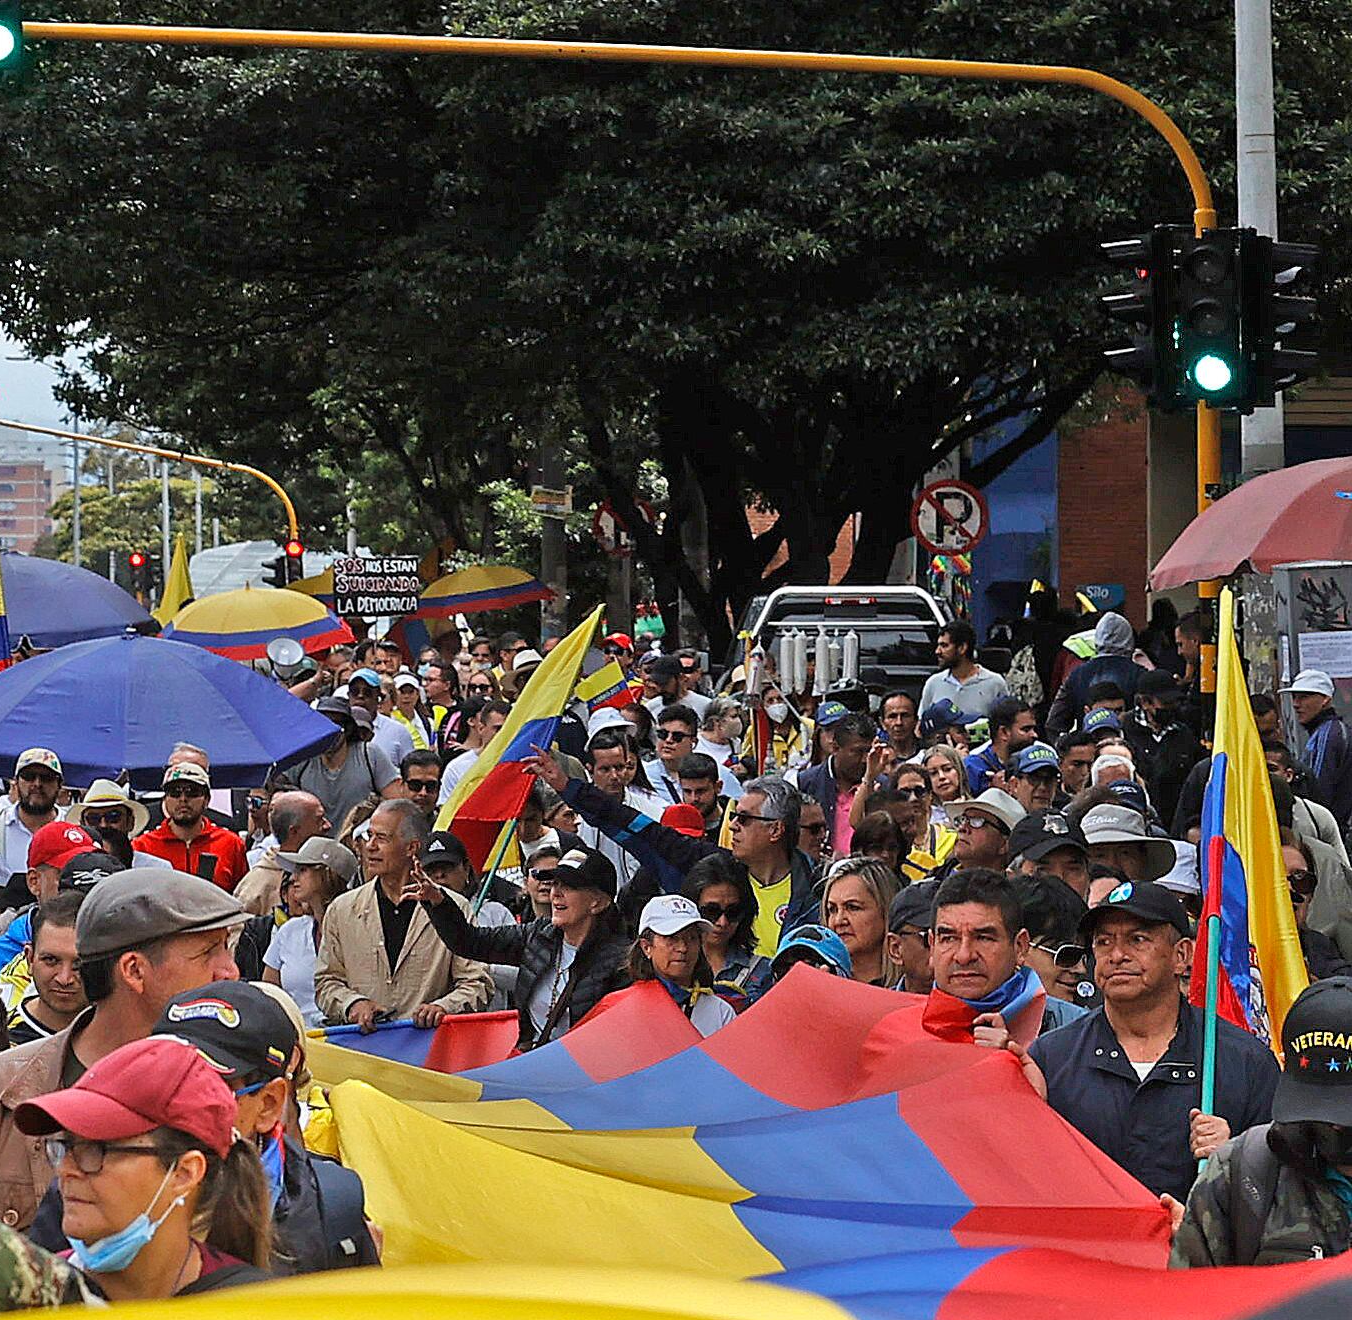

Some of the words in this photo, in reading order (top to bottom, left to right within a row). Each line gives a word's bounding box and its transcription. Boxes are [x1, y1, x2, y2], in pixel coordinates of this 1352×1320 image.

[334, 558, 364, 574] SOS
[383, 560, 417, 573] ESTAN
[336, 574, 419, 593] SUICIDANDO
[337, 598, 354, 613] LA
[357, 596, 418, 613] DEMOCRACIA
